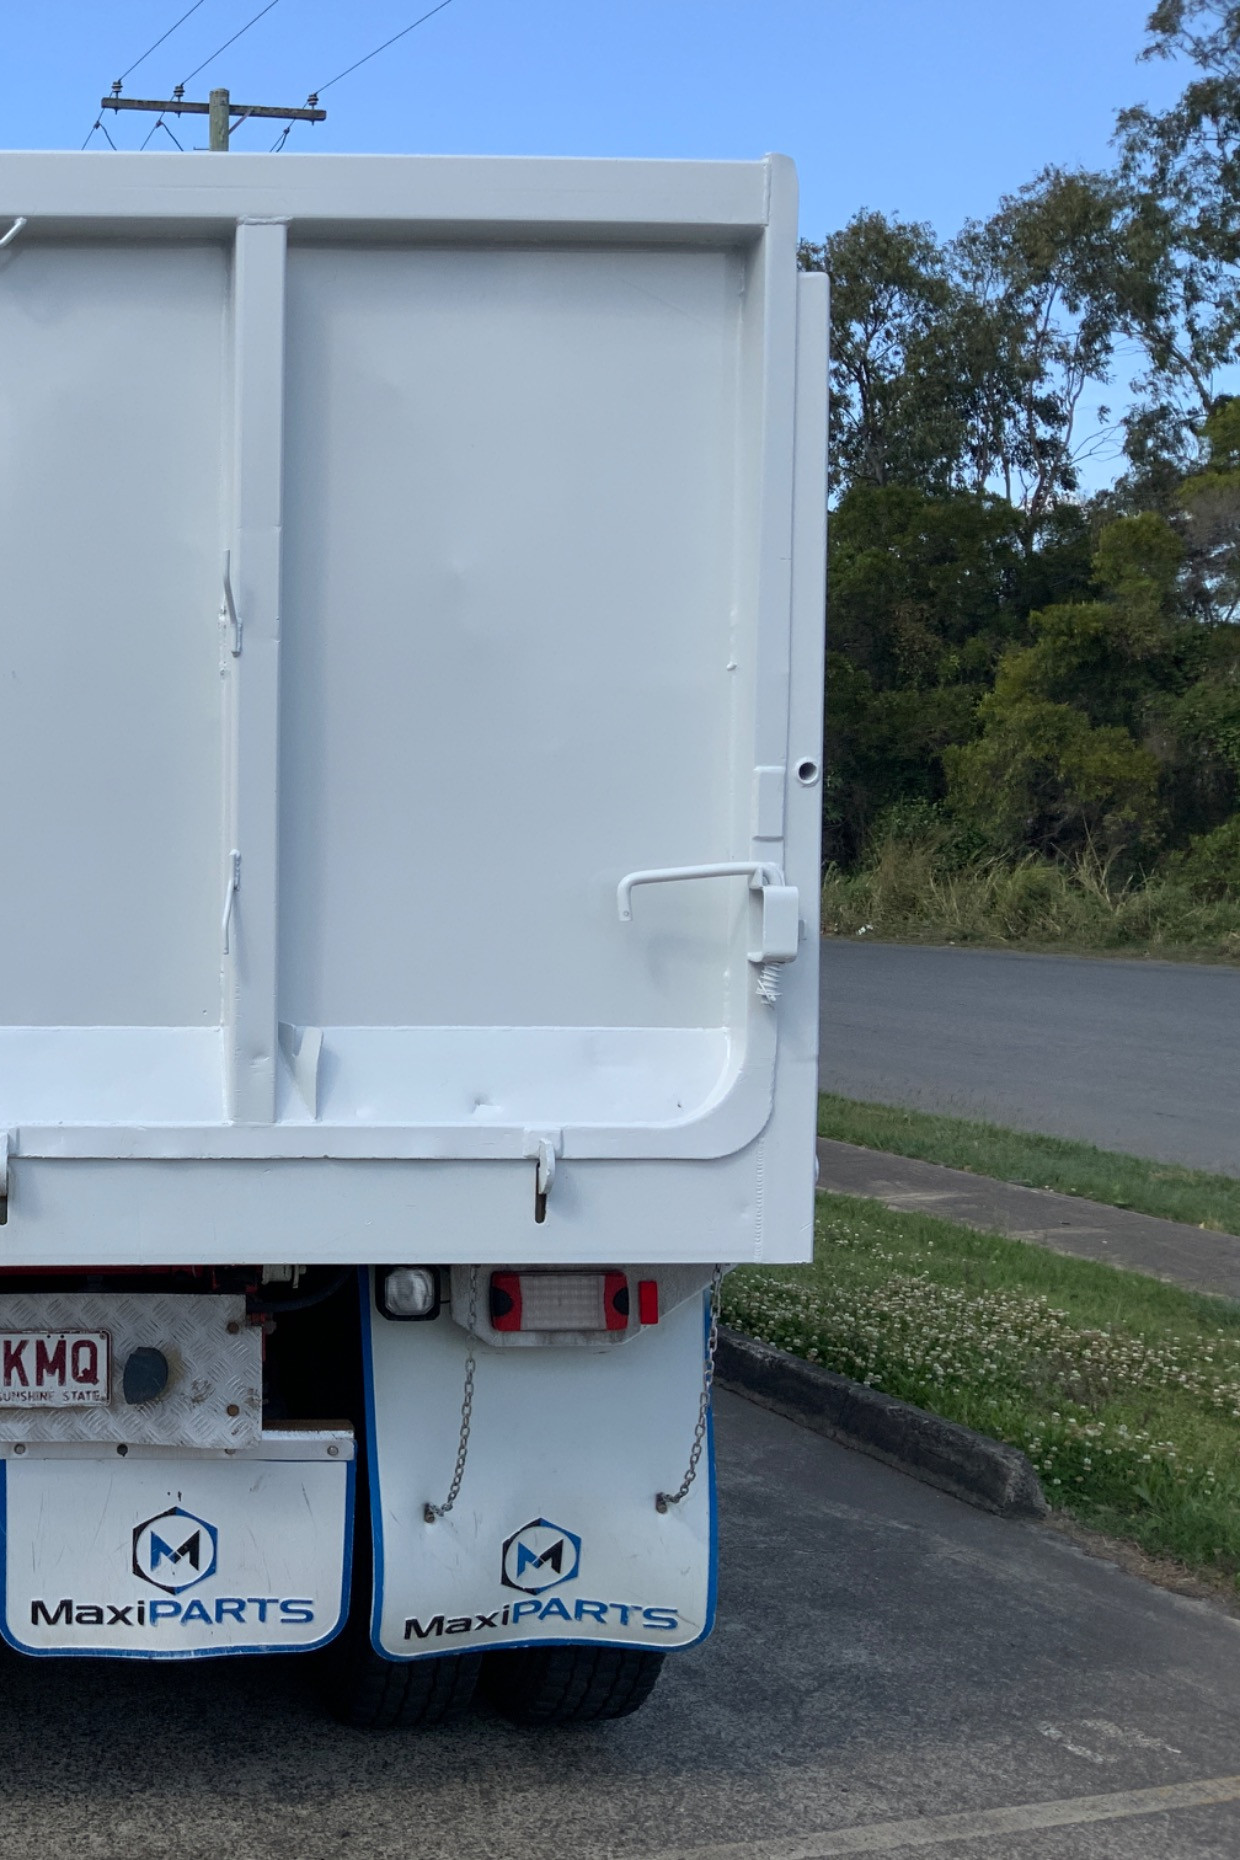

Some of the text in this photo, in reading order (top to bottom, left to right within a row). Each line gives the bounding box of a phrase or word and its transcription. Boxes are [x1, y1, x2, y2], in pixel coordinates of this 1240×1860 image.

[3, 1339, 100, 1386] KMQ
[62, 1390, 101, 1402] STATE
[31, 1598, 314, 1627] MaxiPARTS
[404, 1597, 679, 1640] MaxiPARTS
